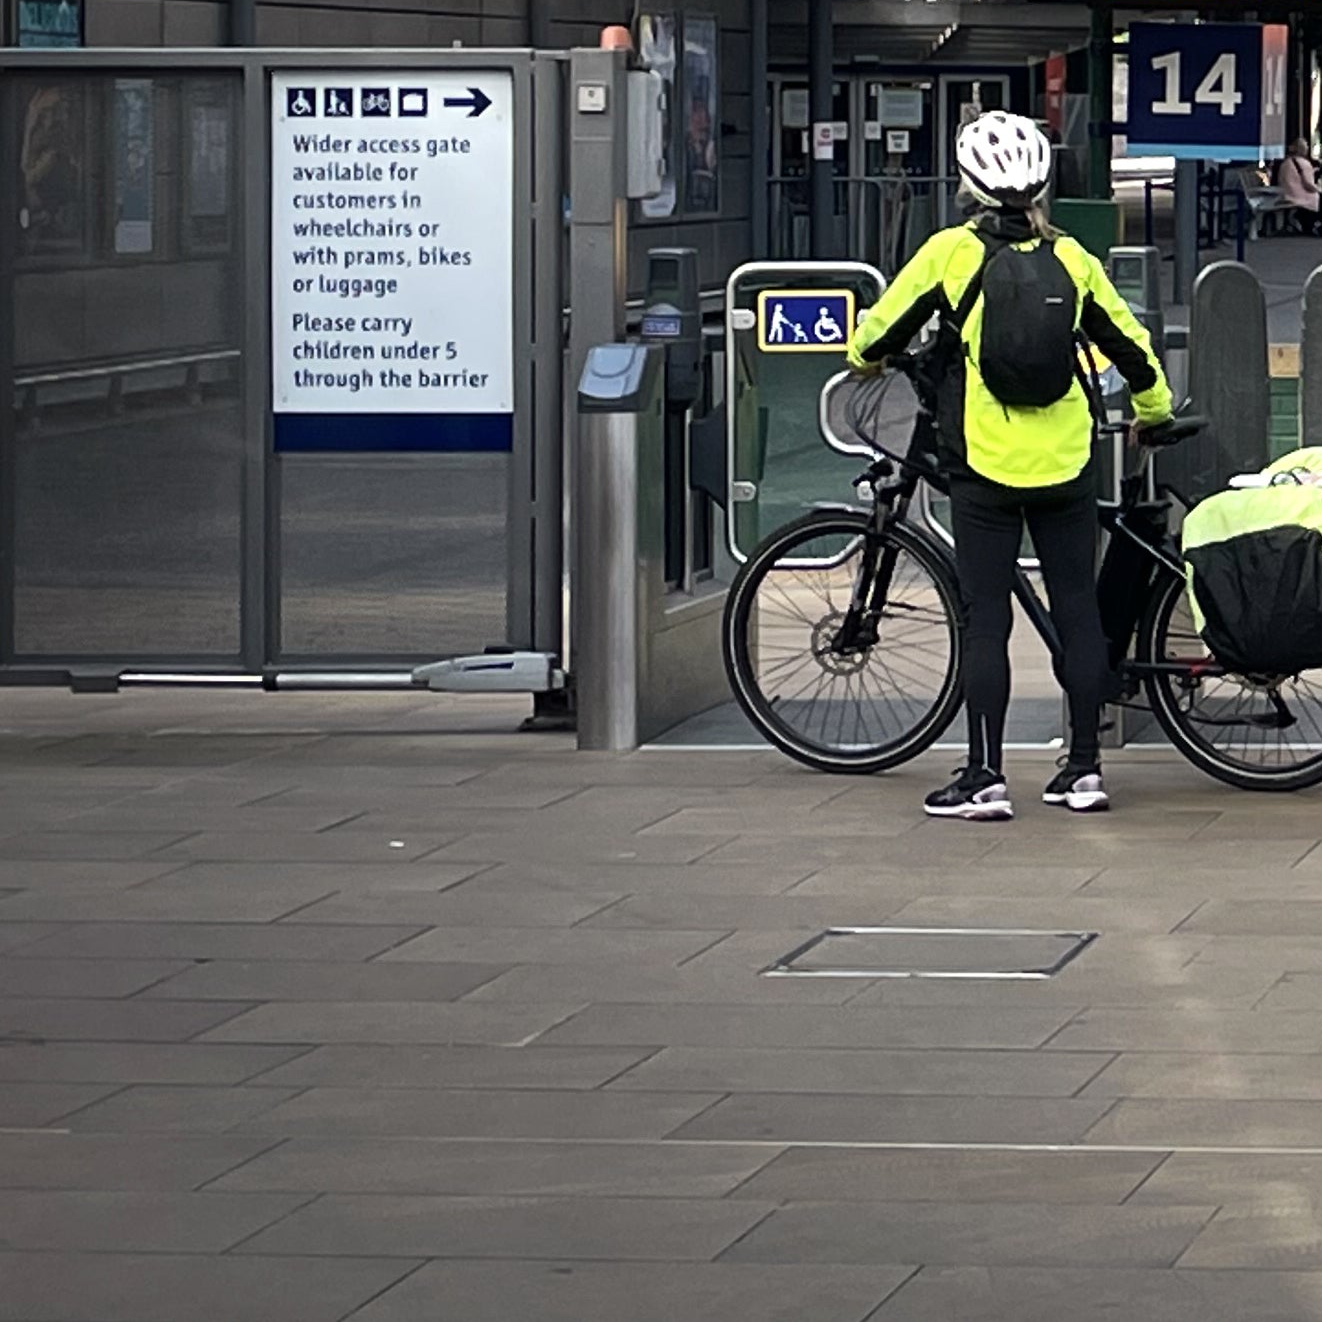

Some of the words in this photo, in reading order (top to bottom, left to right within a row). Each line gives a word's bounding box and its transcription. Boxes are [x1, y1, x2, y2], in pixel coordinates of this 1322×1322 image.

[1151, 51, 1243, 116] 14
[292, 133, 353, 154] Wider
[356, 139, 421, 154] access
[426, 136, 471, 158] gate
[292, 161, 383, 182] available
[388, 161, 419, 182] for
[292, 191, 397, 210] customers
[401, 190, 422, 209] in
[292, 217, 413, 238] wheelchairs
[418, 223, 440, 238] or
[292, 245, 338, 266] with
[344, 250, 412, 270] prams,
[418, 246, 472, 266] bikes
[292, 278, 314, 294] or
[318, 273, 398, 299] luggage
[292, 312, 356, 332] Please
[360, 317, 413, 338] carry
[292, 339, 375, 361] children
[380, 340, 441, 361] under
[445, 341, 458, 361] 5
[293, 368, 374, 393] through
[379, 368, 412, 388] the
[418, 368, 489, 389] barrier
